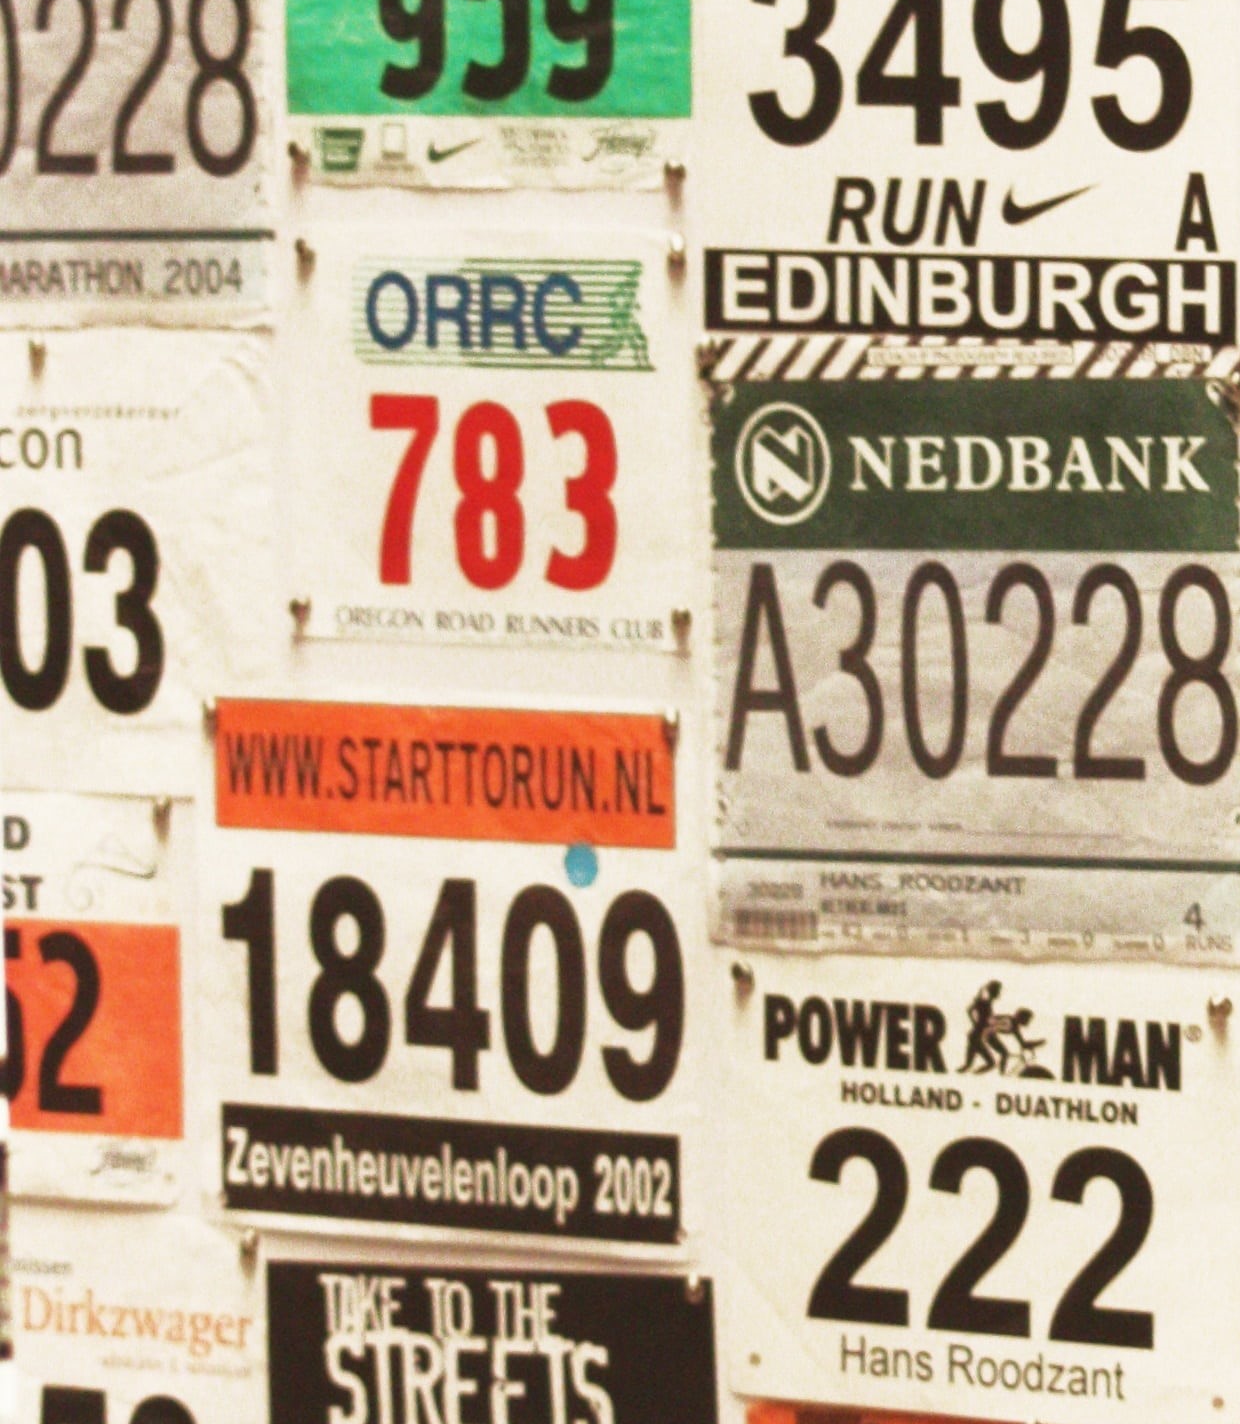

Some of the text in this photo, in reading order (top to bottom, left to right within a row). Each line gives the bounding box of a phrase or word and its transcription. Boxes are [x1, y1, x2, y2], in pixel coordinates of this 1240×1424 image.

[827, 177, 986, 248] RUN
[1174, 172, 1219, 253] A
[365, 271, 584, 354] ORRC
[721, 253, 1222, 335] EDINBURGH
[369, 393, 618, 591] 783
[847, 435, 1211, 492] NEDBANK
[335, 606, 665, 642] OREGON ROAD RUNNERS CLUB
[724, 559, 1239, 787] A30228
[224, 731, 668, 816] WWW.STARTTORUN.NL
[1182, 902, 1206, 931] 4
[221, 868, 686, 1104] 18409
[840, 1080, 1140, 1126] HOLLAND DUATHLON
[226, 1126, 673, 1223] Zevenheuvelenloop 2002
[807, 1125, 1155, 1350] 222
[839, 1335, 1126, 1401] Hans Roodzant
